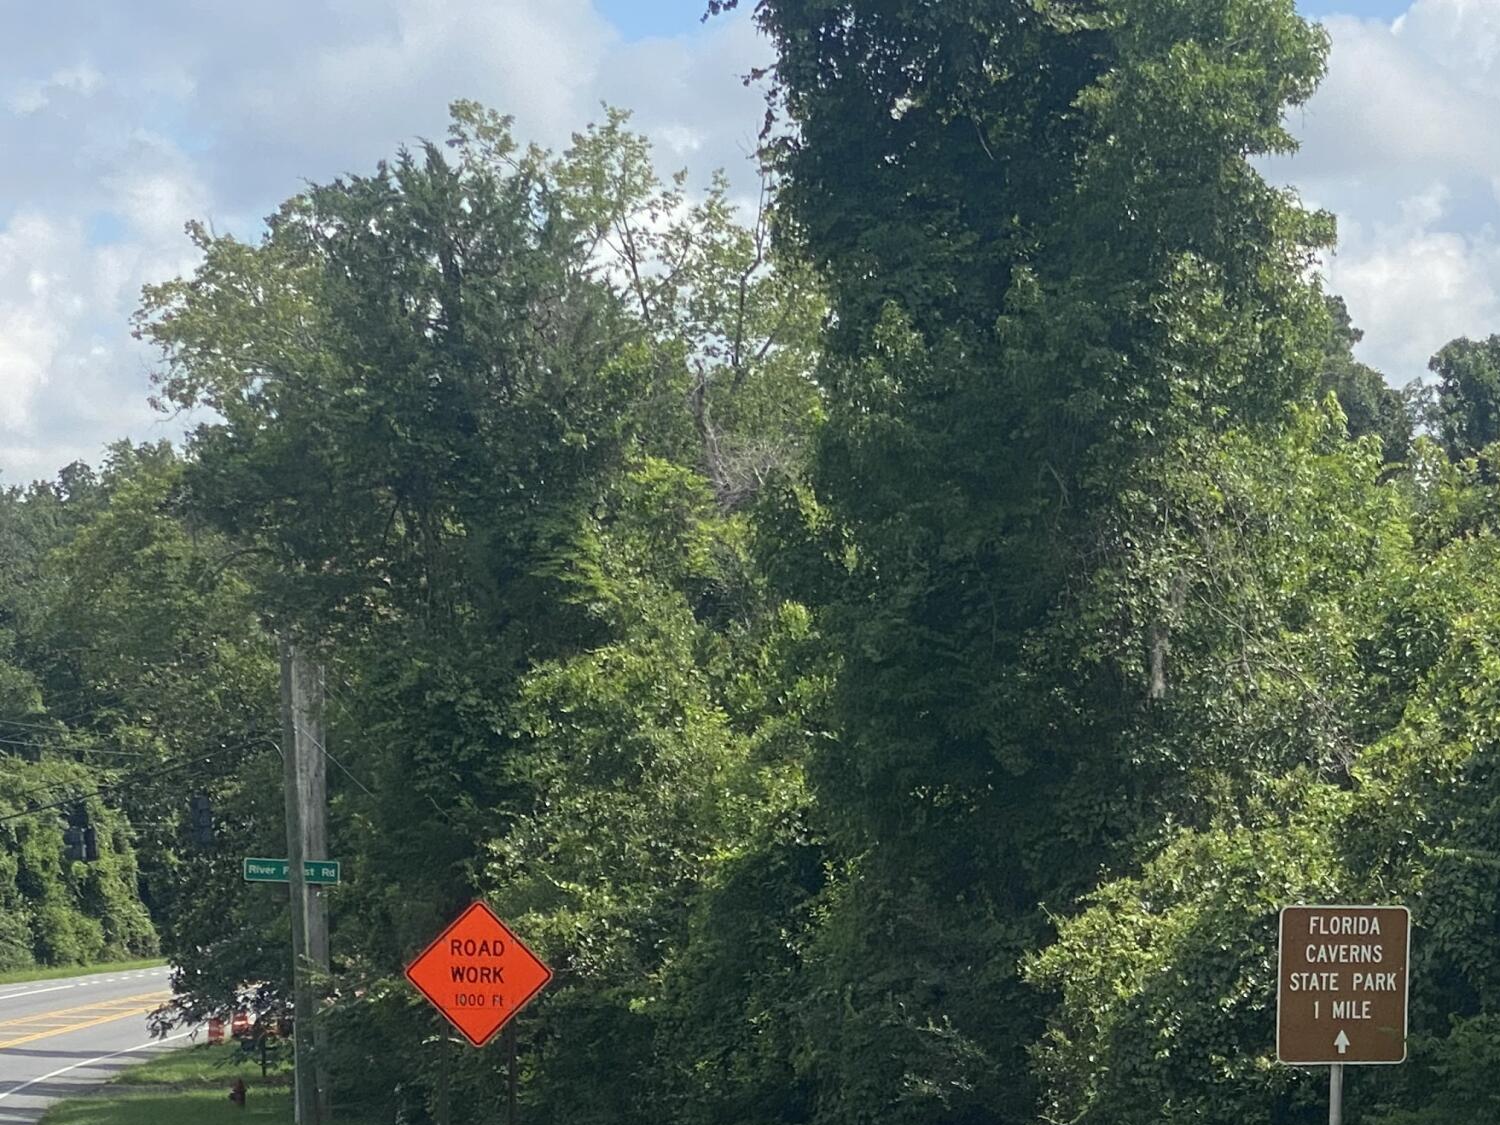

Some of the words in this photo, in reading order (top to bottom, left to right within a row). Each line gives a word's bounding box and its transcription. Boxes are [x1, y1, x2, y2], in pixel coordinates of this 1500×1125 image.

[248, 864, 276, 875] River
[282, 866, 315, 876] Fst
[321, 867, 335, 877] Rd
[1309, 916, 1380, 935] FLORIDA
[450, 939, 505, 957] ROAD
[1305, 944, 1383, 963] CAVERNS
[450, 966, 504, 984] WORK
[1289, 973, 1339, 991] STATE
[1352, 973, 1397, 991] PARK
[455, 993, 485, 1007] 1000
[1313, 1001, 1319, 1019] 1
[1332, 1001, 1372, 1019] MILE
